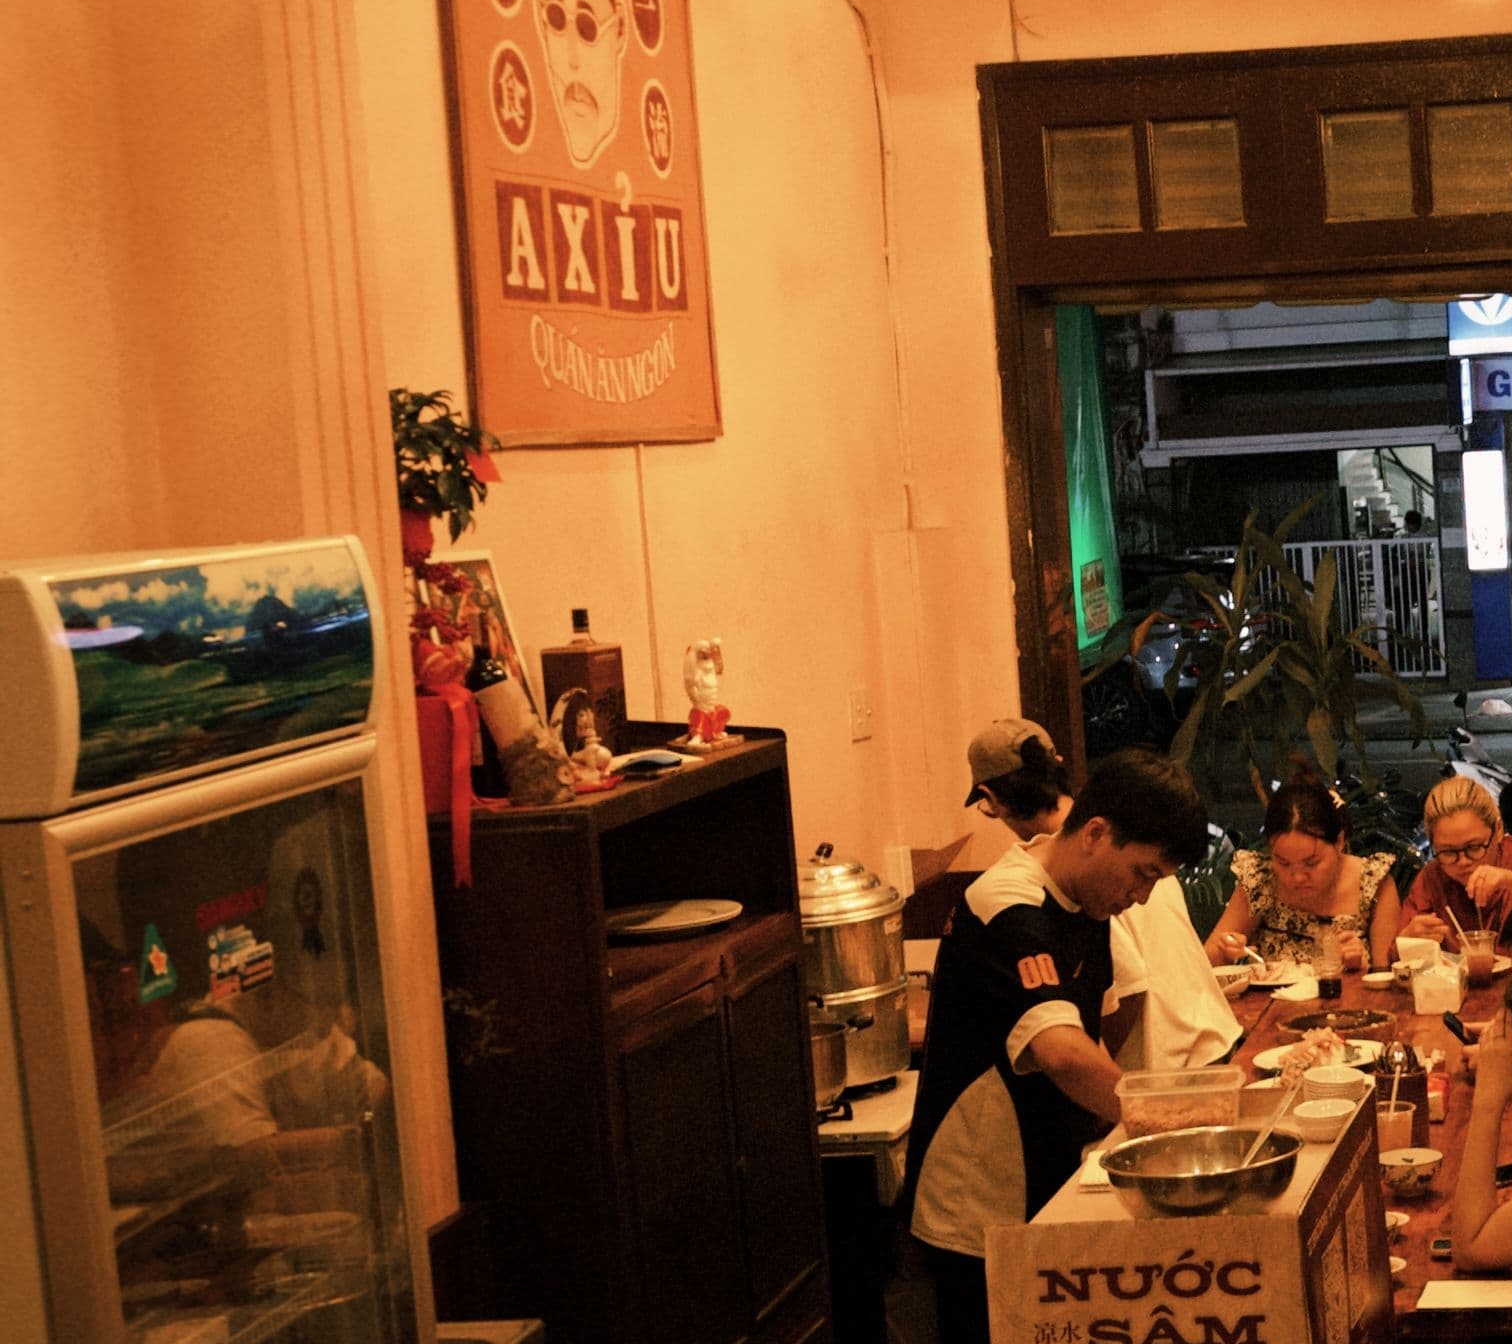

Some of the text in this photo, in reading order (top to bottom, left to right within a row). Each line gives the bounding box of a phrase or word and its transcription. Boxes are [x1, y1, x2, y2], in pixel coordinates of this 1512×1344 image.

[531, 313, 595, 399] QUÁN
[626, 321, 676, 403] NGON
[1036, 1249, 1262, 1304] NƯỚC
